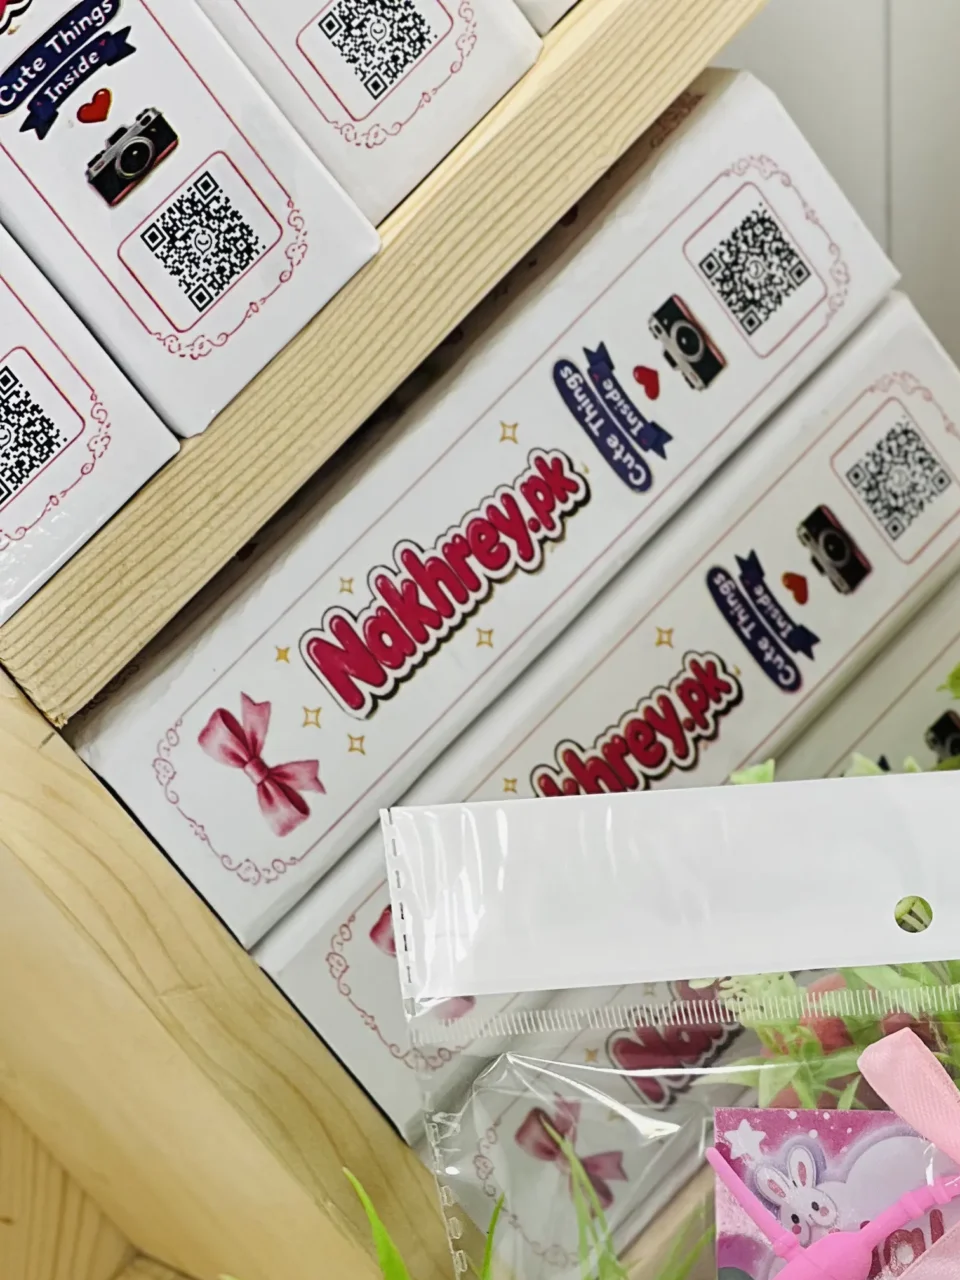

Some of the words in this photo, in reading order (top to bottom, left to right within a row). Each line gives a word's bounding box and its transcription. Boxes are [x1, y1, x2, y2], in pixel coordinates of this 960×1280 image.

[0, 57, 46, 106] Cute
[44, 0, 113, 54] Things
[44, 51, 100, 103] Inside
[559, 365, 605, 437] Things
[602, 378, 644, 437] Inside
[605, 434, 647, 486] Cute
[304, 453, 582, 712] Nakhrey.pk
[713, 572, 757, 640] Things
[754, 584, 794, 639] Inside
[757, 636, 797, 686] Cute
[537, 658, 733, 797] hrey.pk
